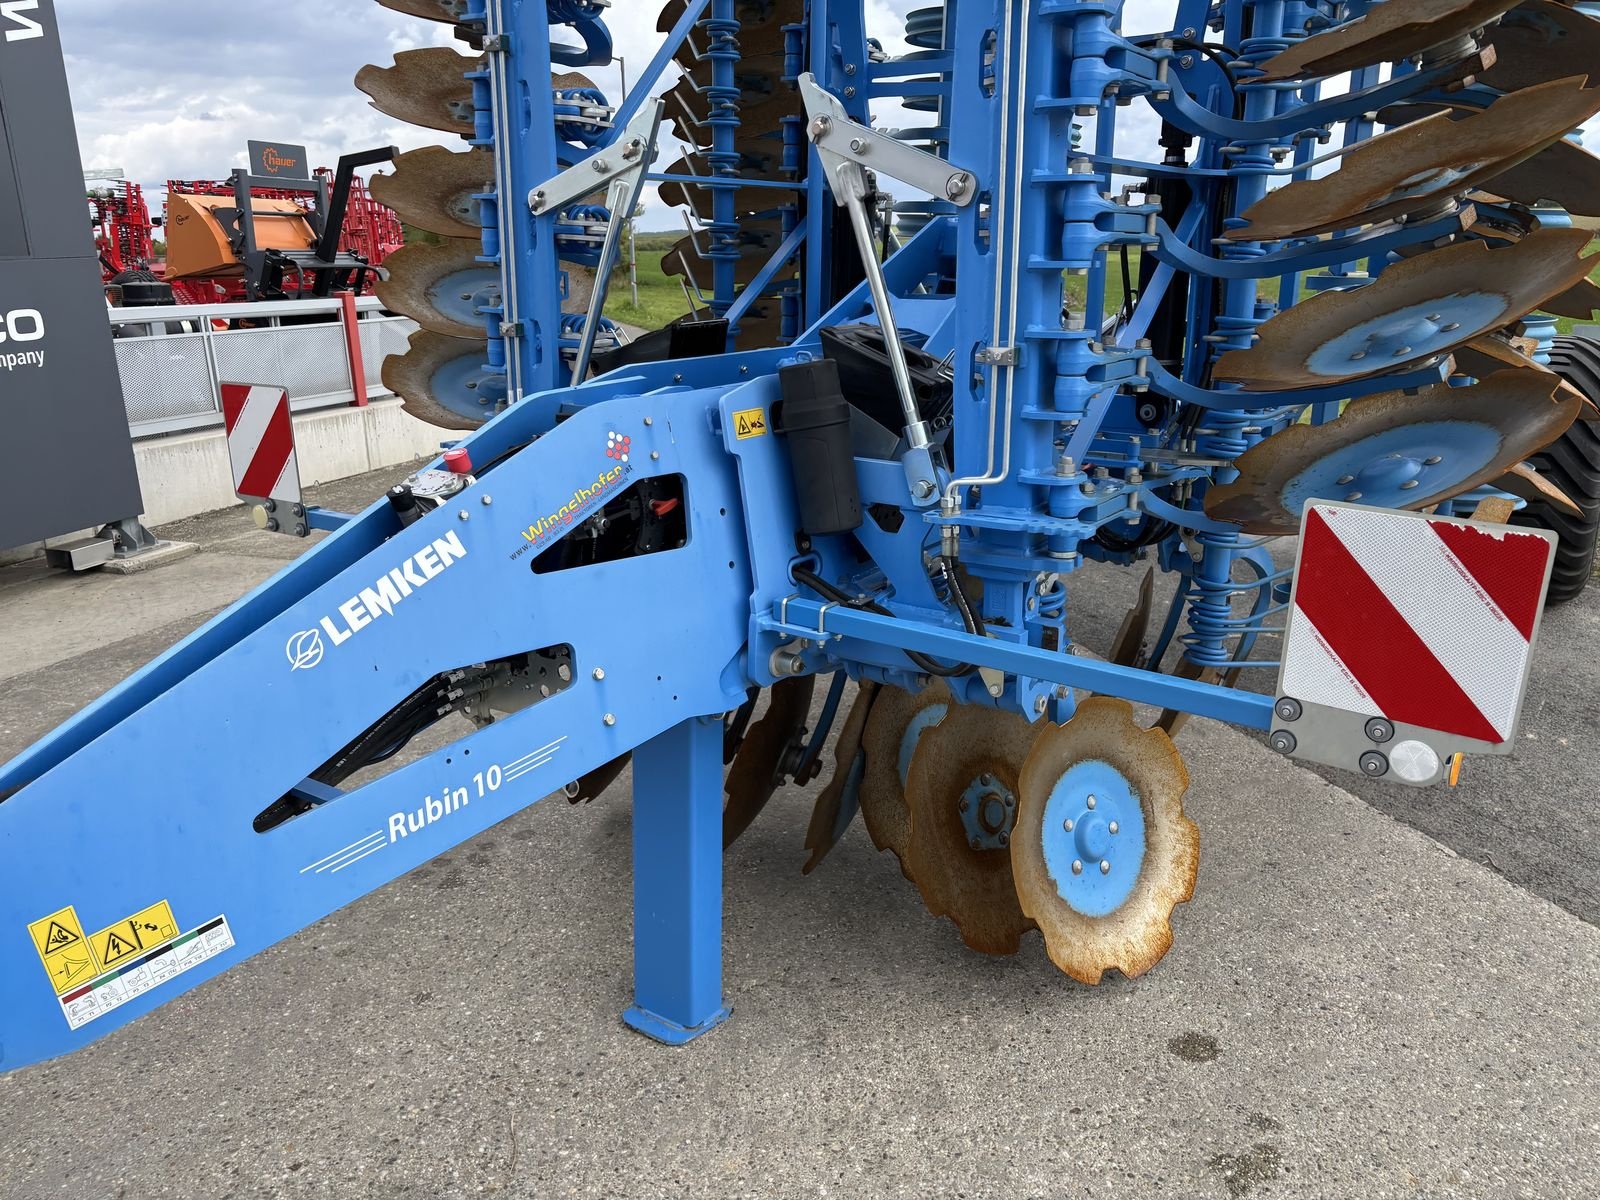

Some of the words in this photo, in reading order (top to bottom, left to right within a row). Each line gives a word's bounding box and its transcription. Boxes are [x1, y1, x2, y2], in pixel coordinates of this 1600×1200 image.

[268, 152, 296, 167] hauer
[319, 529, 468, 646] LEMKEN
[387, 788, 469, 844] Rubin
[474, 764, 504, 798] 10
